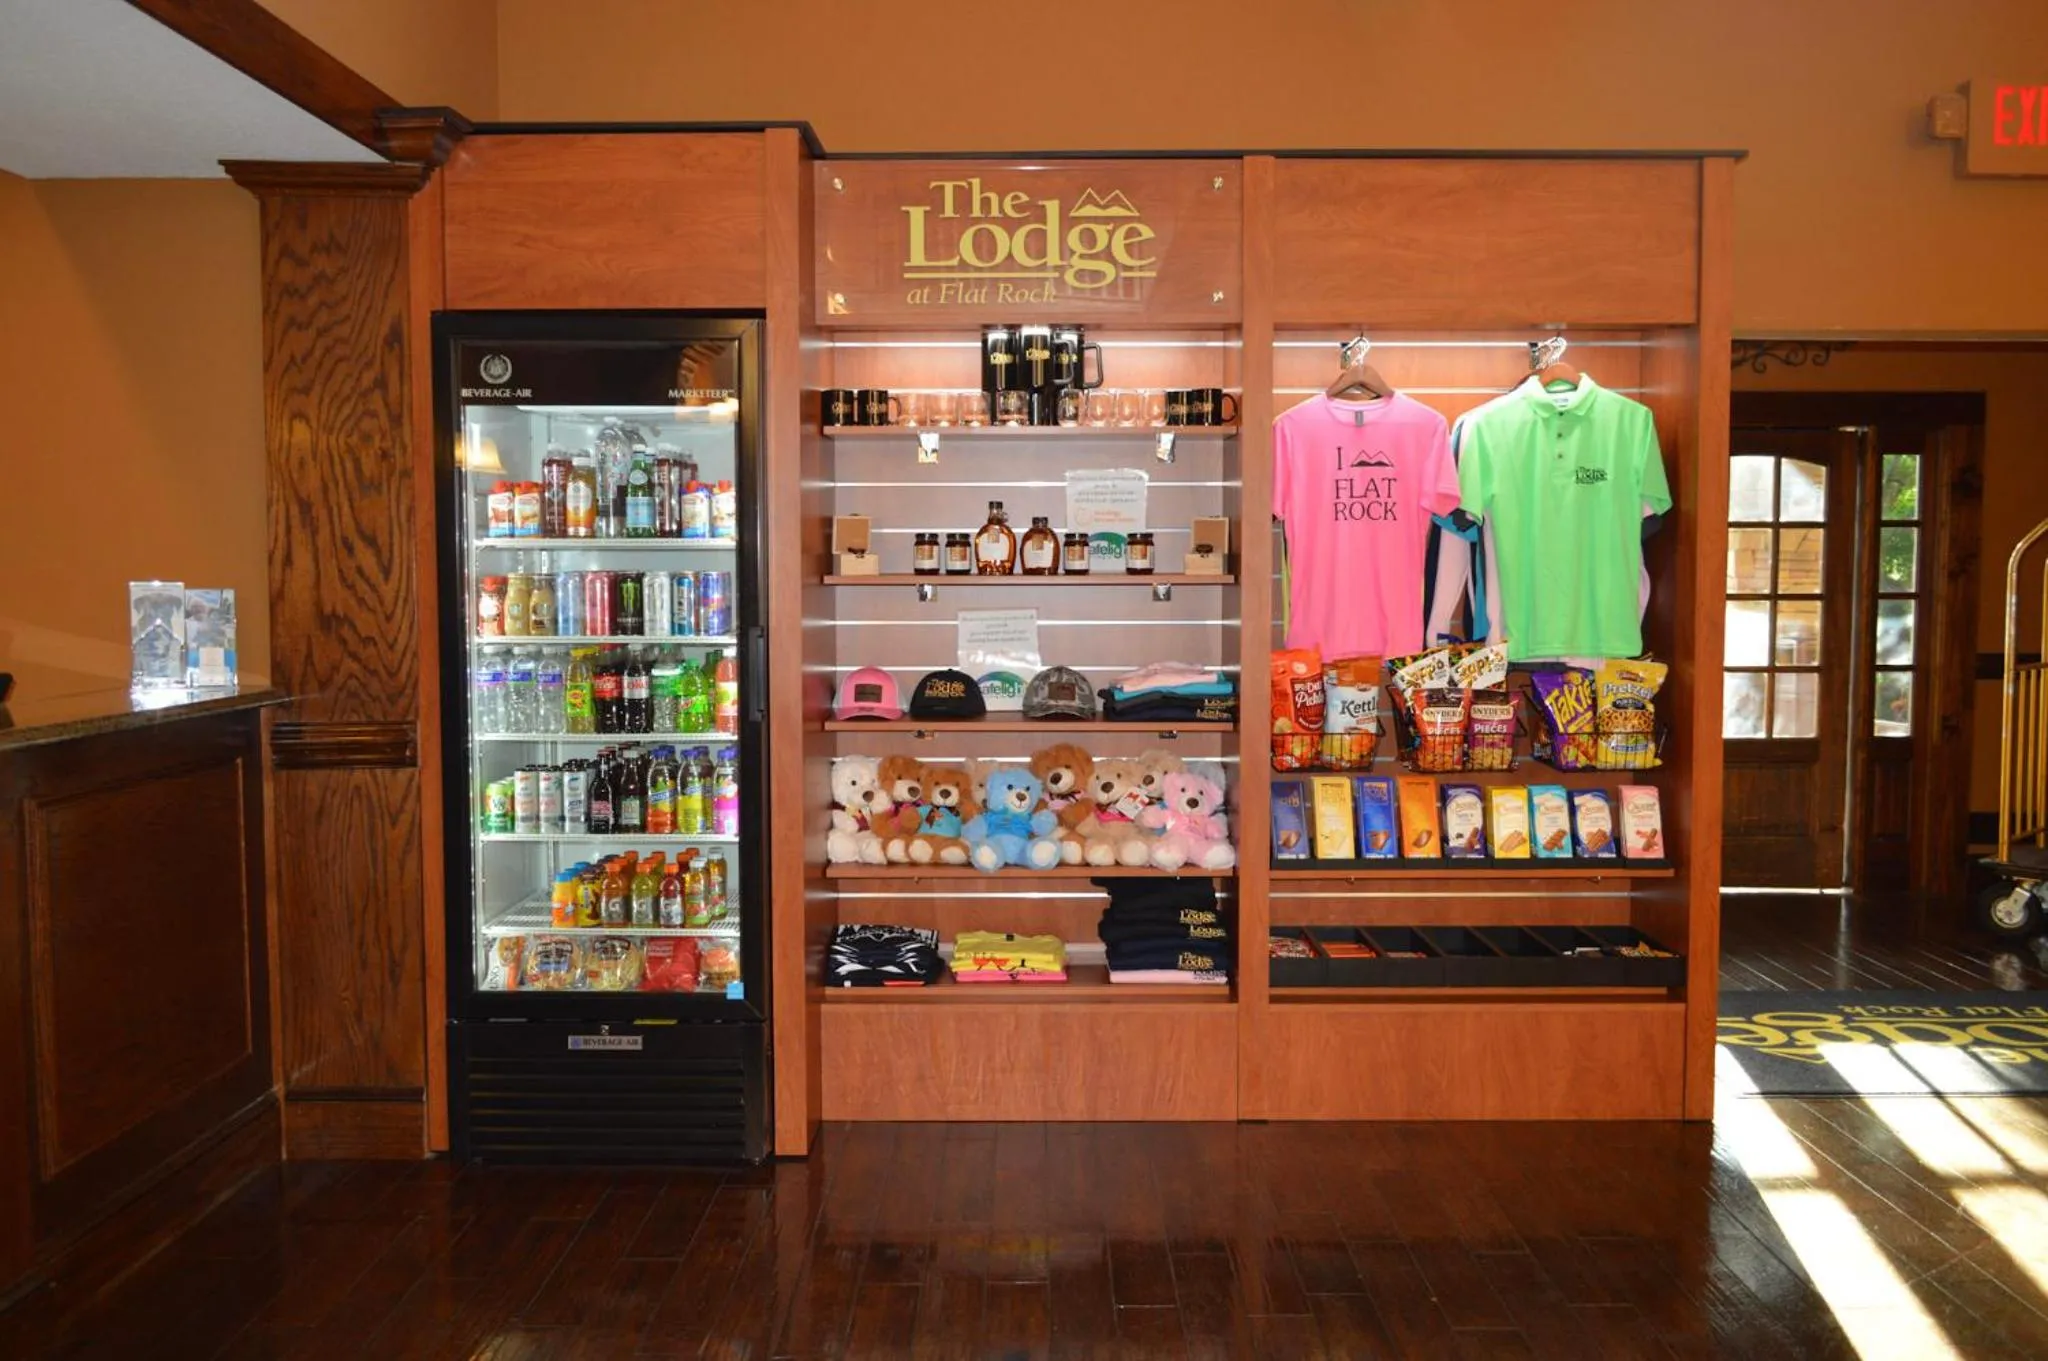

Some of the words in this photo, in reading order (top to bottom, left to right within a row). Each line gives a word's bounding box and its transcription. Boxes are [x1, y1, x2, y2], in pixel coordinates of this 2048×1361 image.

[930, 178, 1031, 218] The
[901, 199, 1157, 289] Lodge
[906, 286, 931, 305] at
[938, 282, 988, 305] Flat
[997, 281, 1058, 305] Rock
[461, 388, 533, 398] BEVERAGE-AIR
[668, 388, 729, 399] MARKETEER
[1336, 445, 1343, 471] I
[1334, 477, 1398, 500] FLAT
[1333, 500, 1398, 521] ROCK
